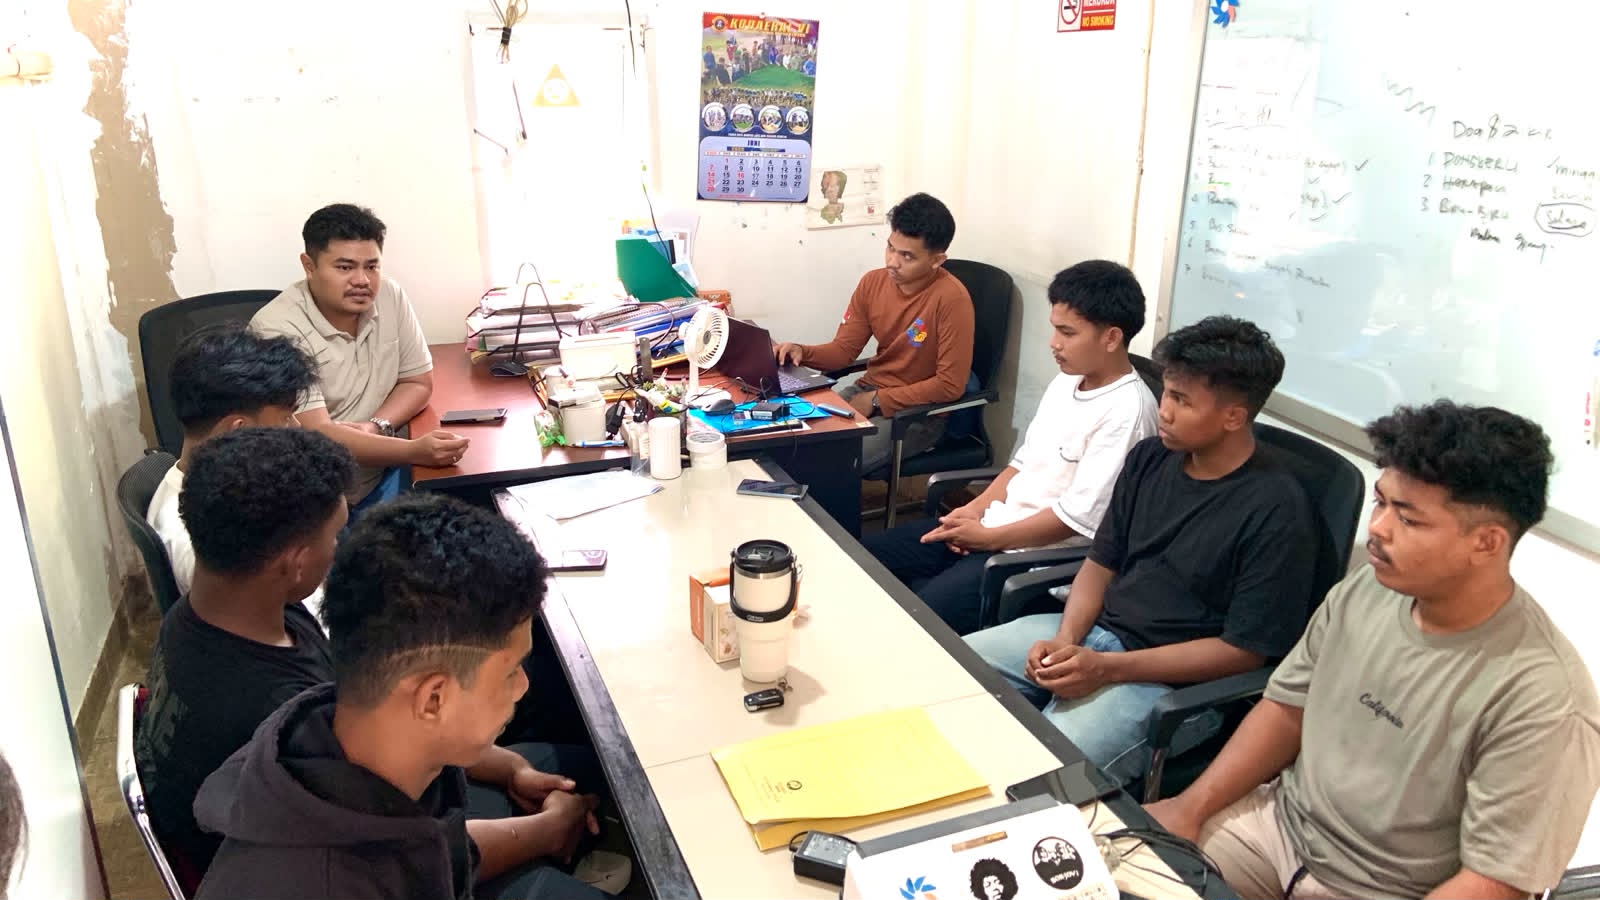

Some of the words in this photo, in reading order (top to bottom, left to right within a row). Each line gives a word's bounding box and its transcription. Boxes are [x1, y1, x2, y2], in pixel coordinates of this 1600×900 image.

[1081, 16, 1090, 27] NO
[1090, 15, 1114, 26] SMOKING
[1359, 692, 1404, 729] California
